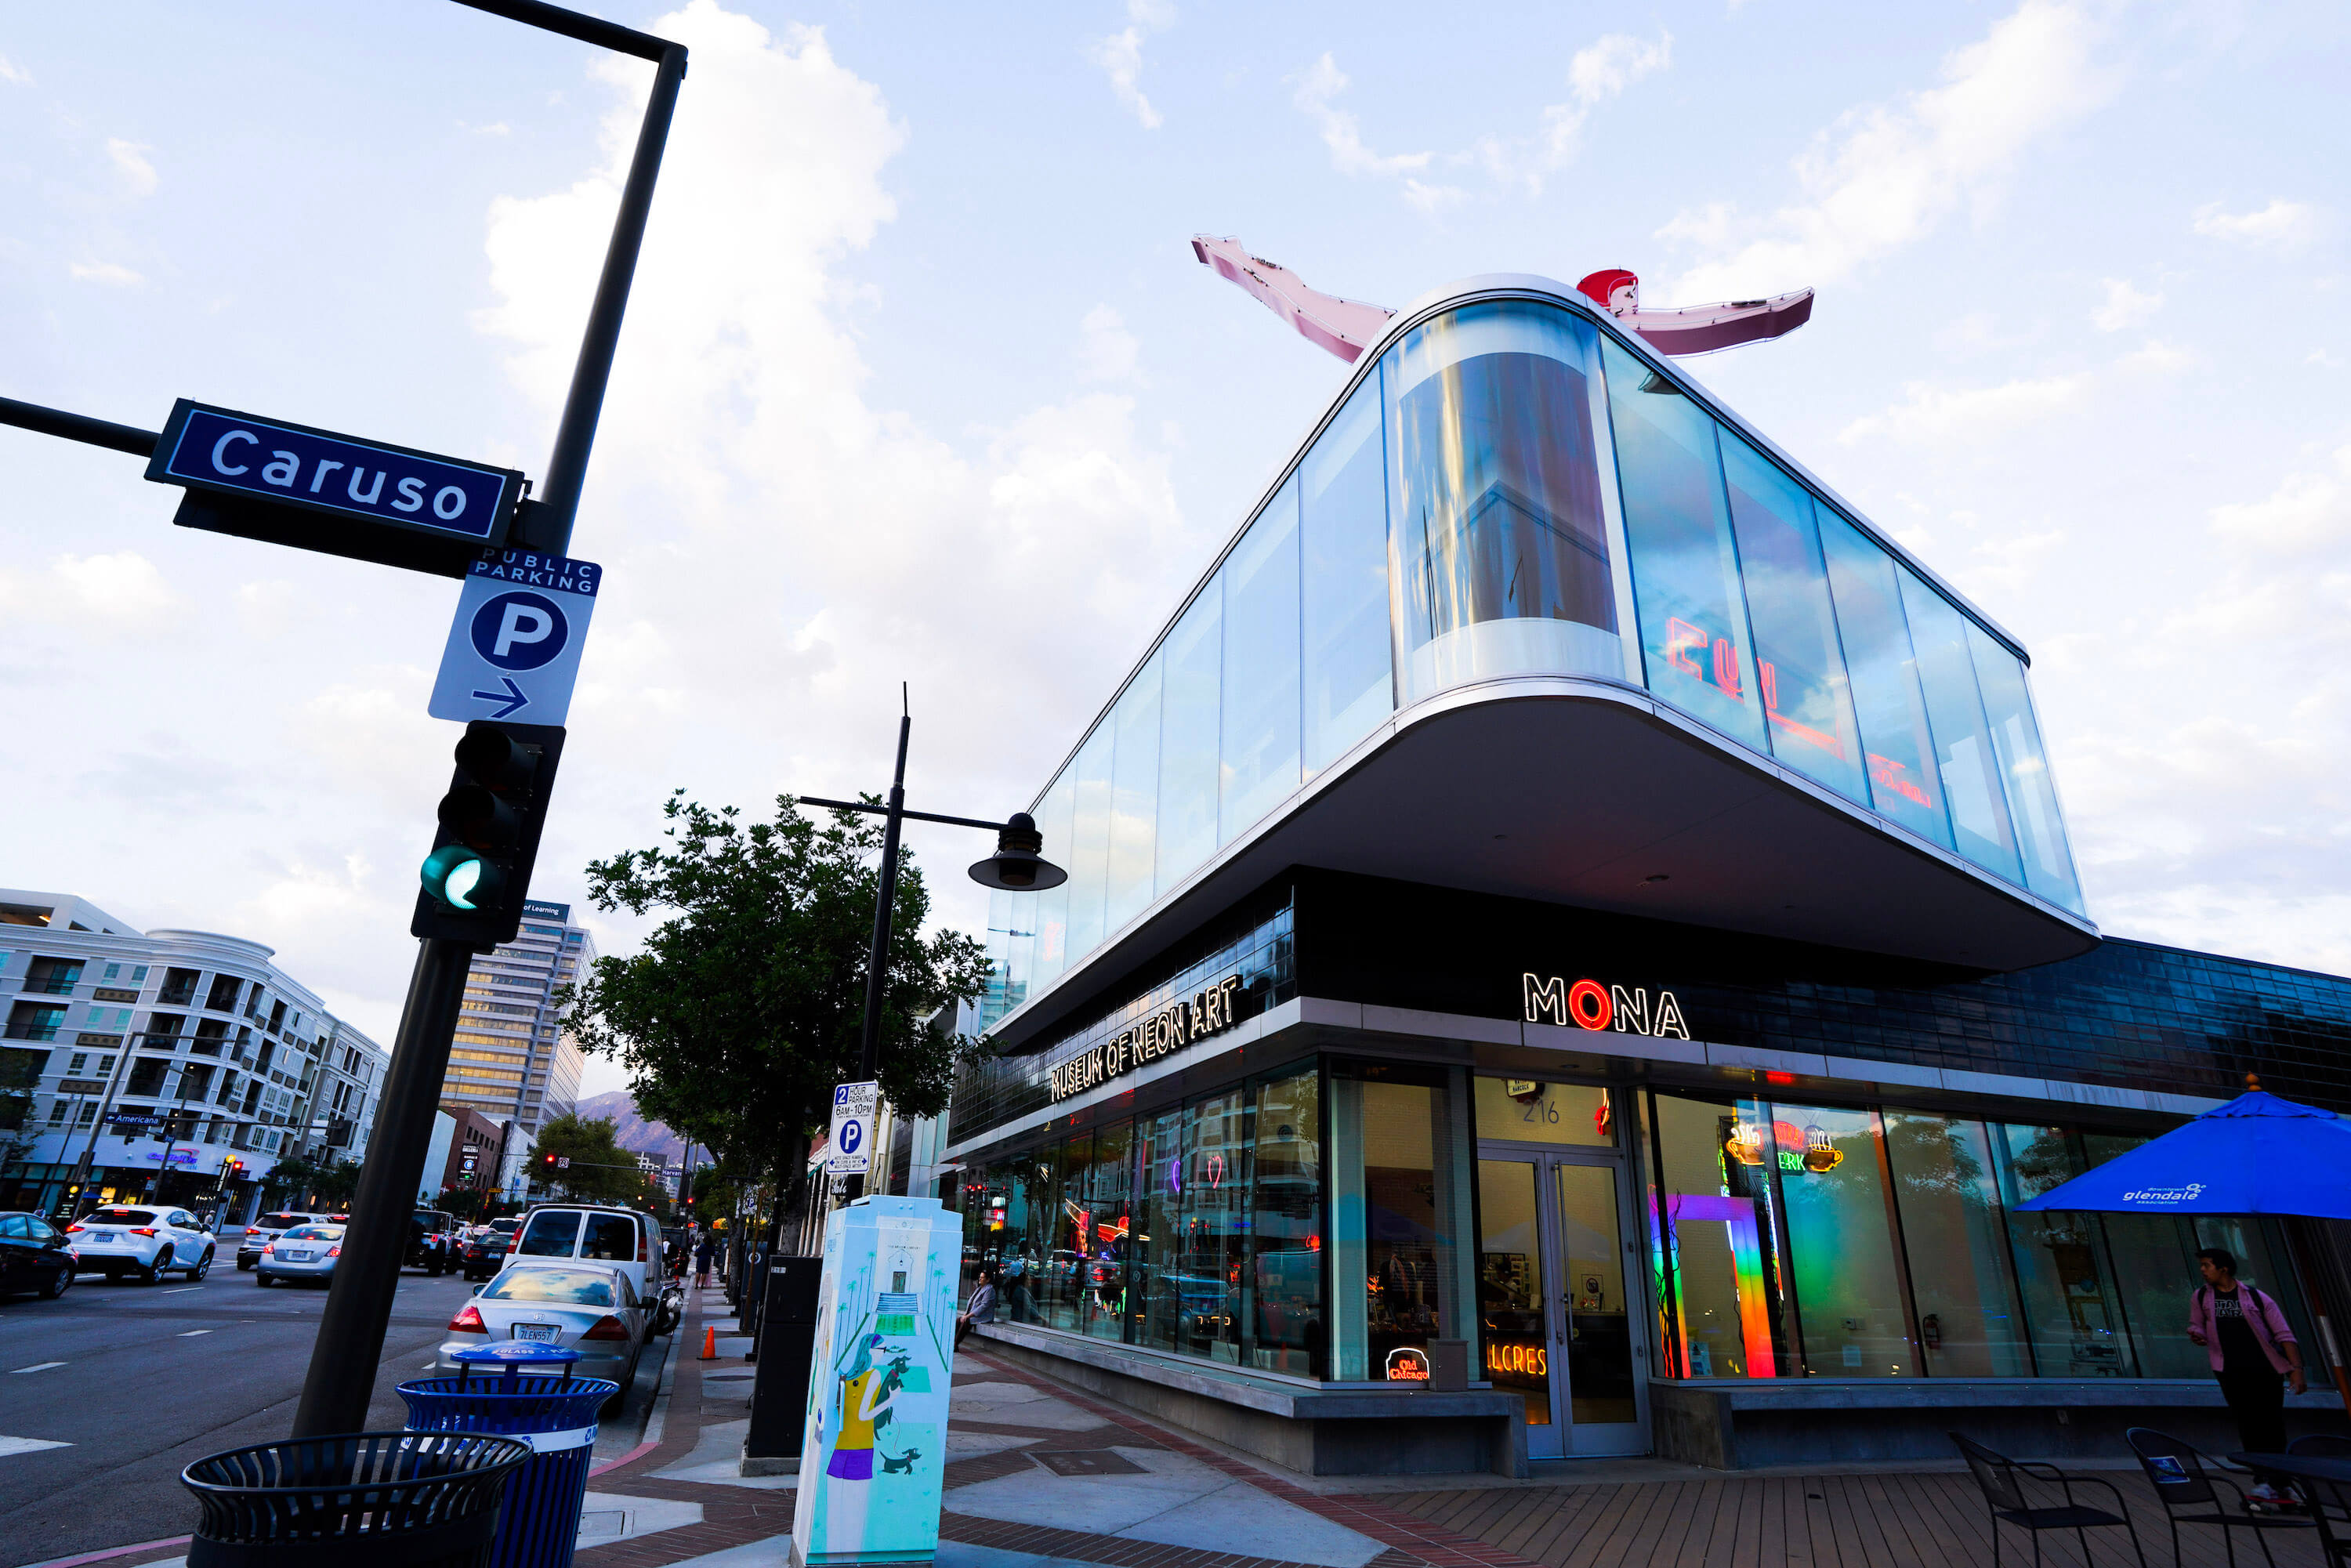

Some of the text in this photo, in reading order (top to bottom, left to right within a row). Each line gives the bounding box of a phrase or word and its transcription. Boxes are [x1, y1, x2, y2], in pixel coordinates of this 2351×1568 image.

[212, 430, 466, 520] Caruso
[482, 548, 592, 578] PUBLIC
[475, 561, 592, 592] PARKING
[493, 602, 553, 657] P
[532, 905, 560, 916] Learning
[1523, 972, 1690, 1041] MONA
[1051, 976, 1237, 1103] MUSEUM OF NEON ART
[838, 1086, 867, 1104] 2 HOUR
[848, 1095, 874, 1104] PARKING
[115, 1114, 159, 1124] Americana
[1523, 1099, 1559, 1124] 216
[845, 1124, 859, 1150] P
[1777, 1152, 1806, 1171] ERK
[662, 1168, 682, 1176] Harvar
[2122, 1190, 2199, 1201] glendale
[520, 1329, 552, 1342] 7LEN557
[1399, 1360, 1418, 1371] Old
[1389, 1368, 1429, 1382] Chicago
